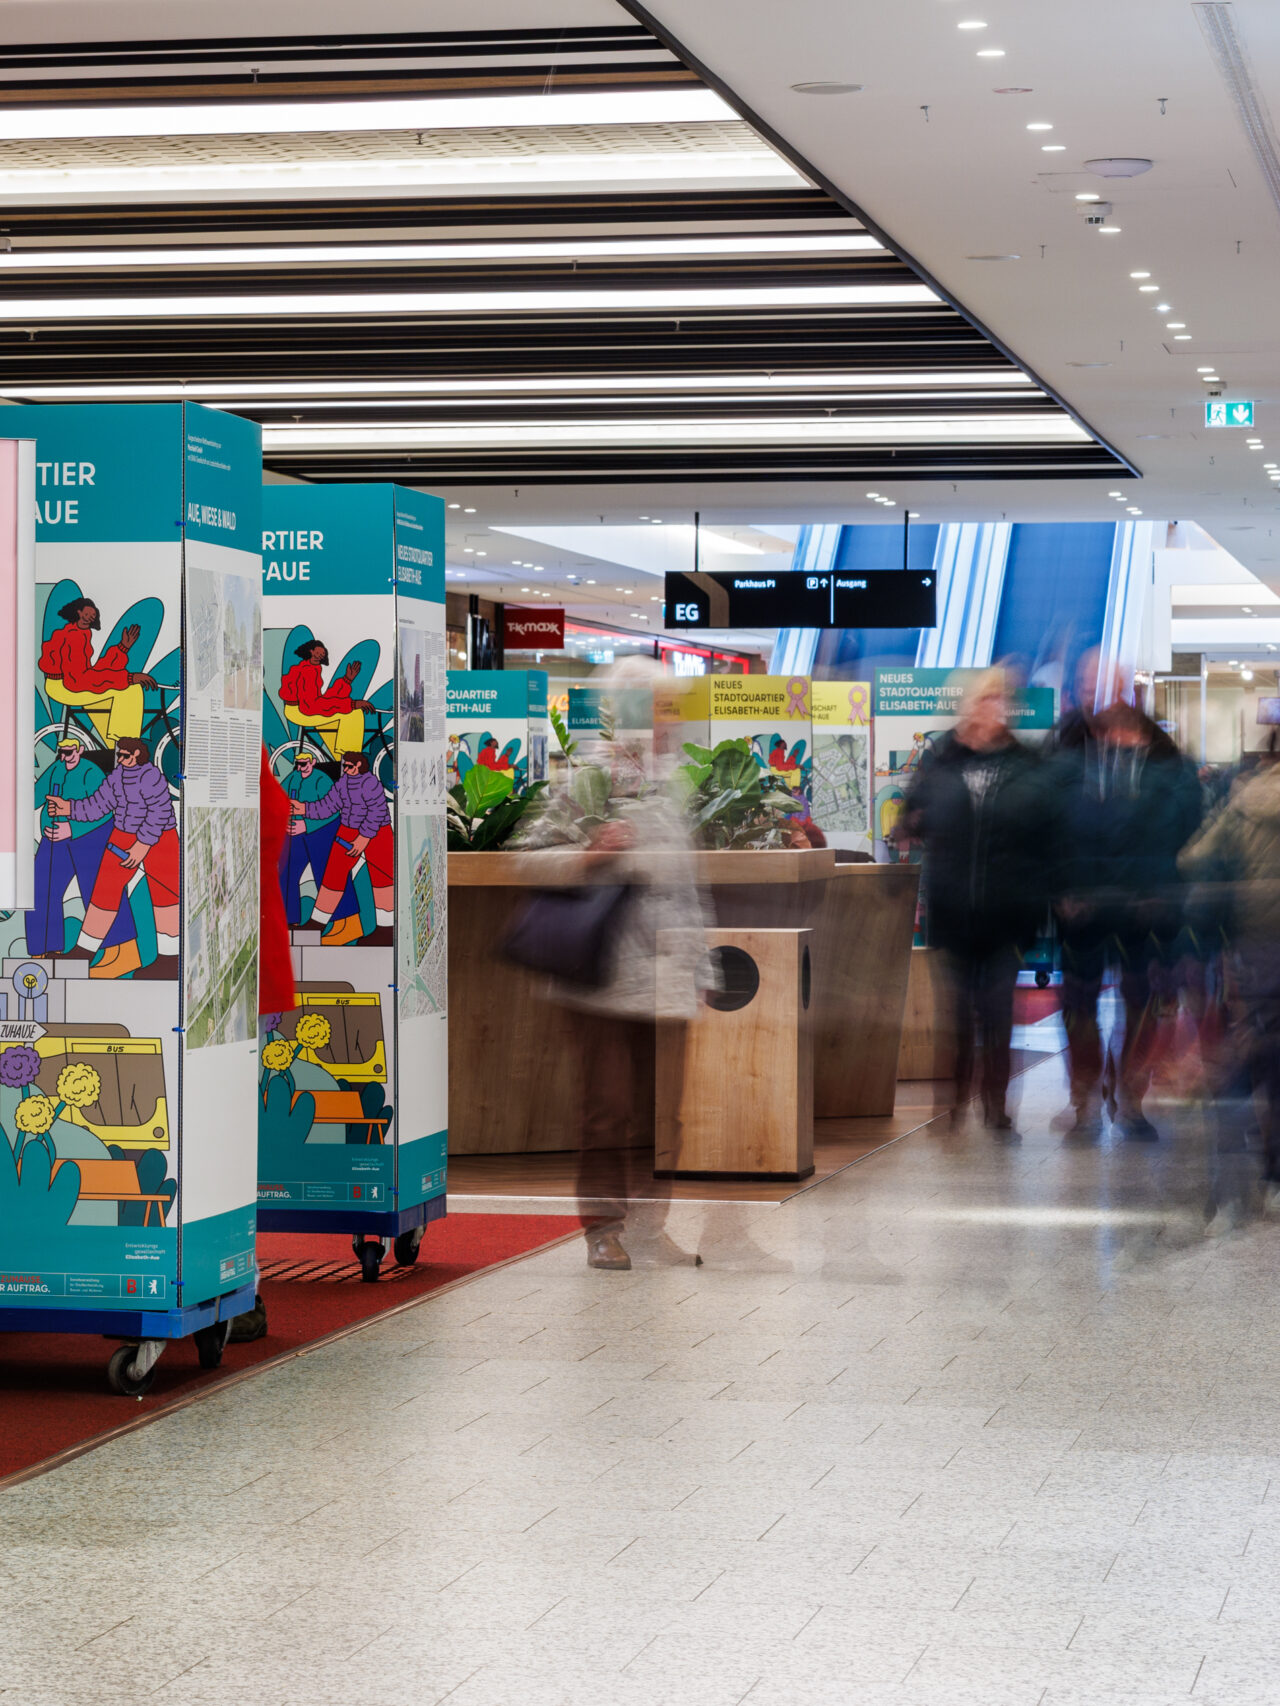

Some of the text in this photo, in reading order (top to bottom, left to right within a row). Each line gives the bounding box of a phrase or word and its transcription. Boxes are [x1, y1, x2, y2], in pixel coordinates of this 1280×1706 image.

[222, 509, 237, 531] WALD
[734, 579, 767, 588] Parkhaus
[836, 579, 867, 589] Ausgang
[675, 603, 699, 621] EG
[879, 673, 913, 683] NEUES
[714, 680, 743, 689] NEUES
[879, 687, 963, 697] STADTQUARTIER
[714, 693, 785, 703] STADTQUARTIER
[714, 706, 780, 715] ELISABETH-AUE
[879, 701, 958, 711] ELISABETH-AUE
[0, 1024, 38, 1039] ZUHAUSE
[257, 1191, 292, 1199] AUFTRAG.
[353, 1186, 362, 1198] B
[0, 1274, 44, 1285] ZUHAUSE.
[7, 1284, 51, 1294] AUFTRAG.
[127, 1279, 137, 1294] B
